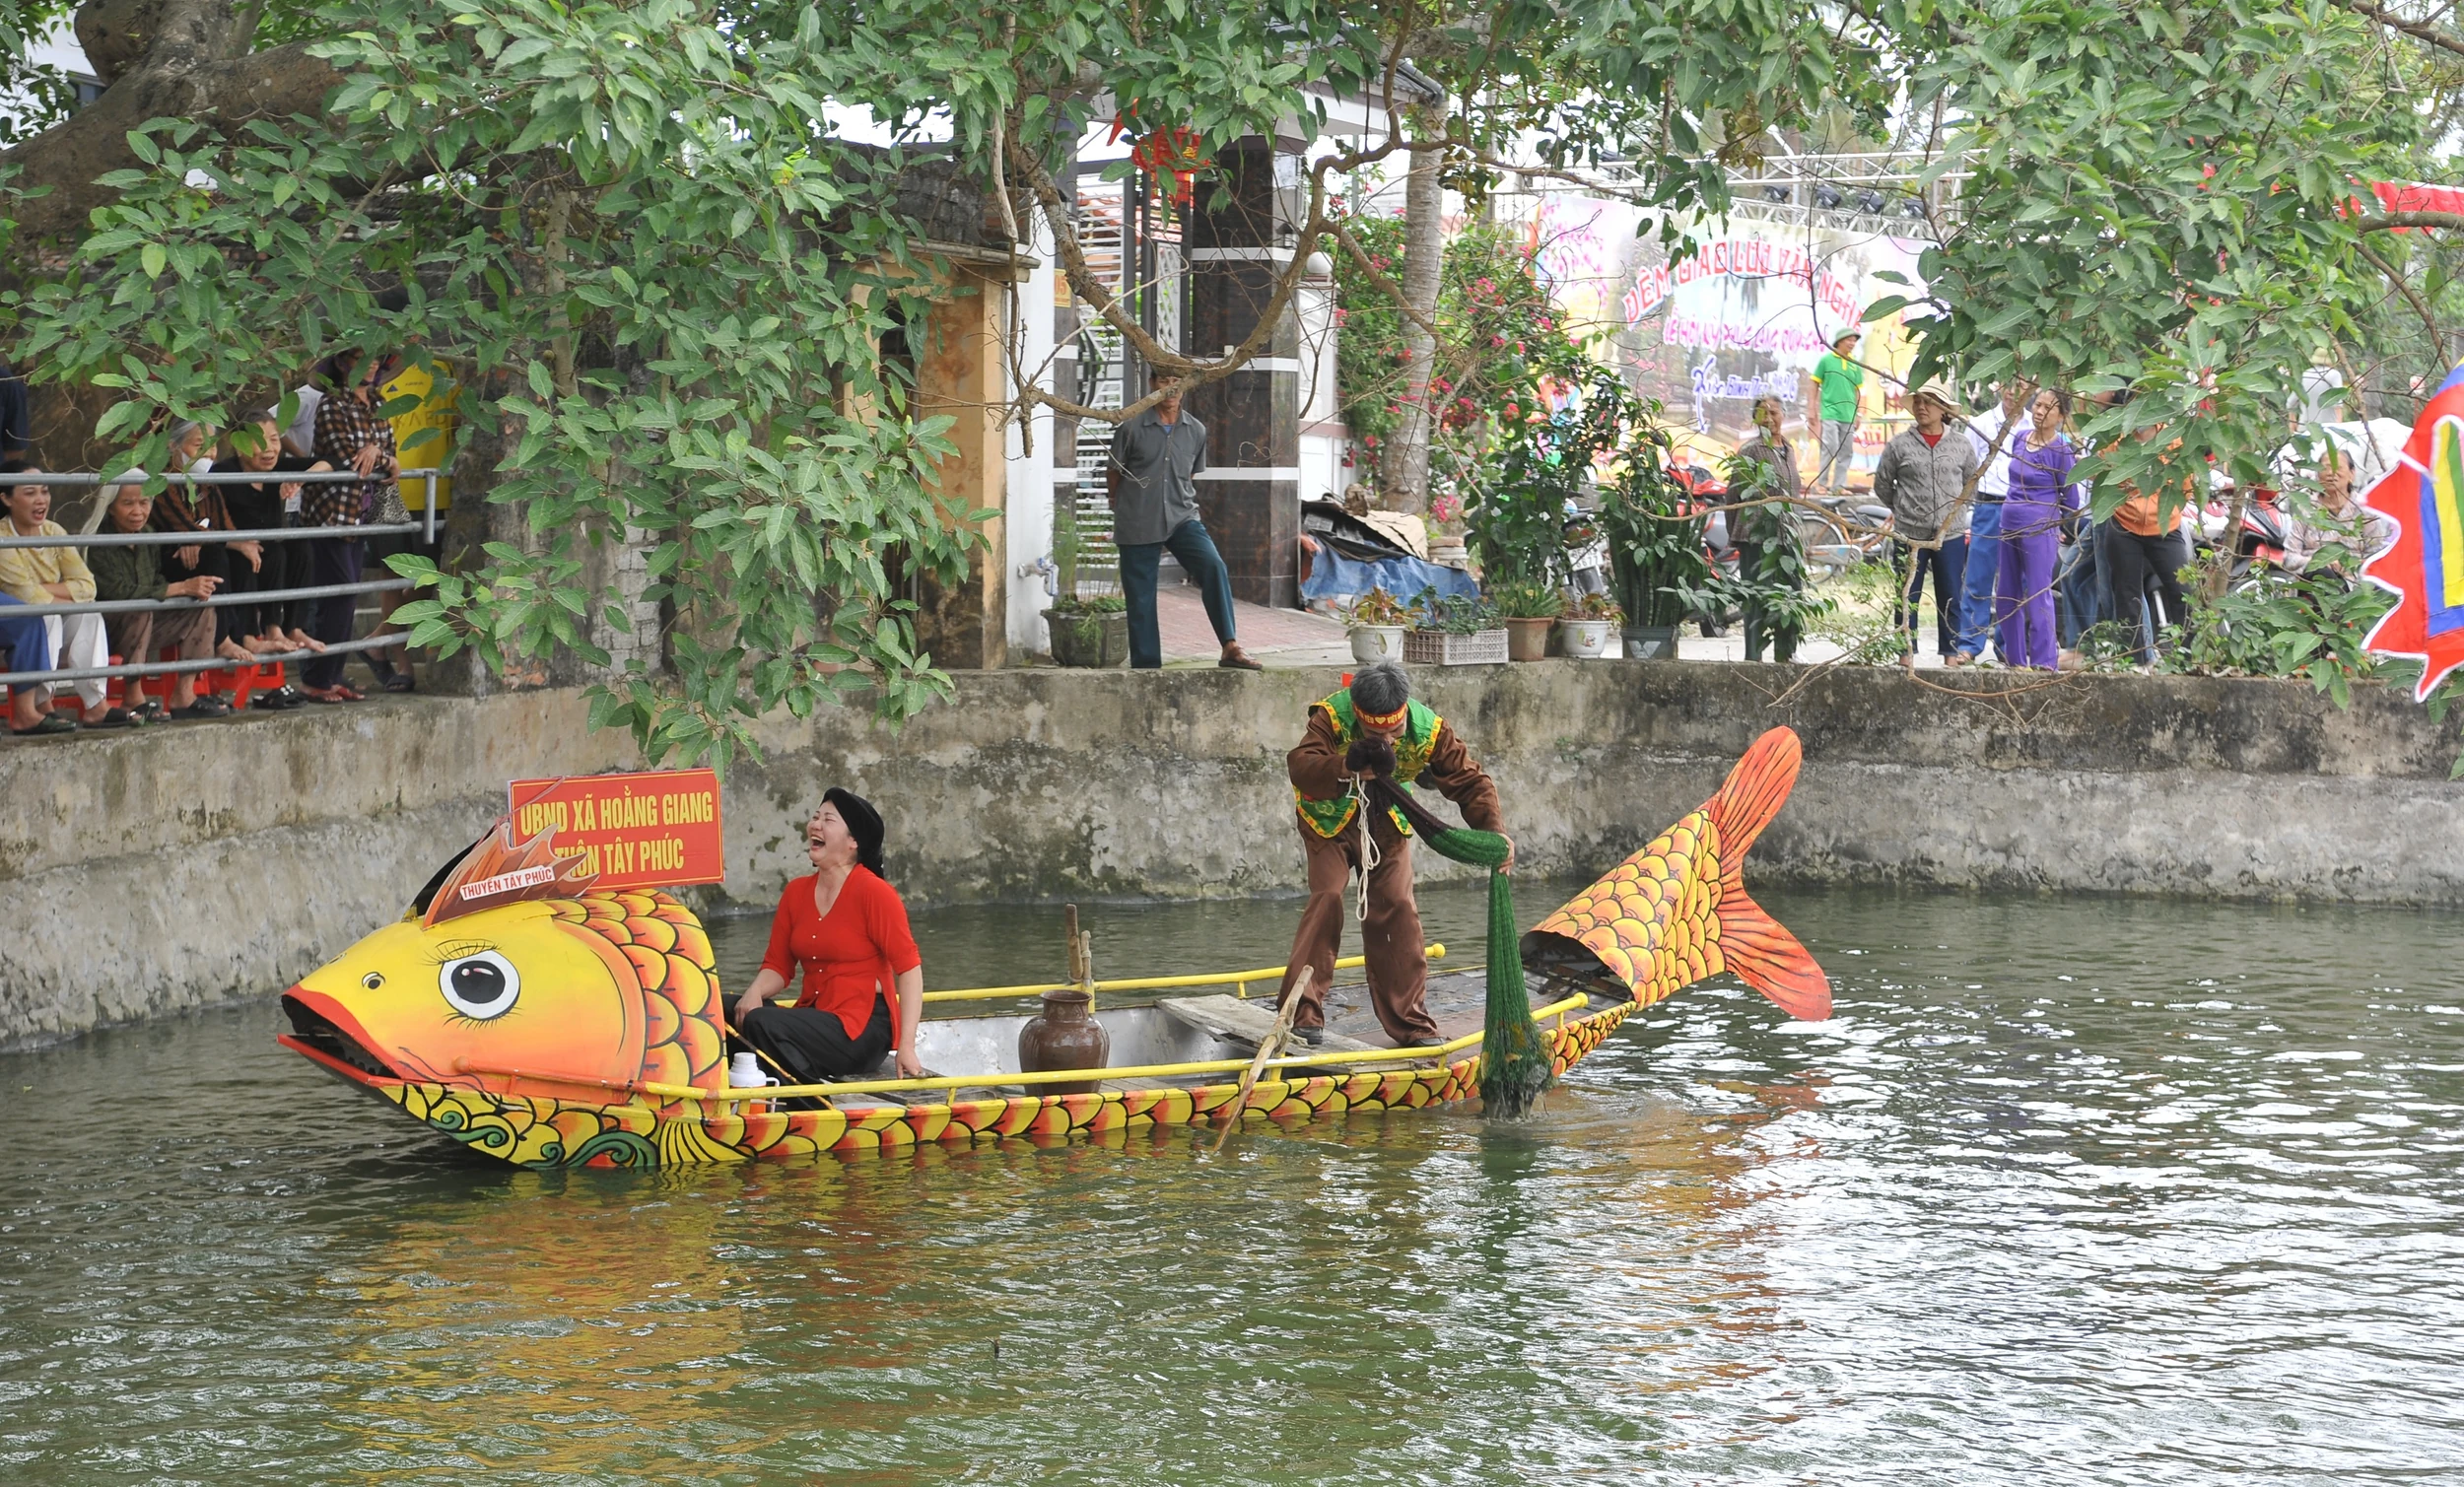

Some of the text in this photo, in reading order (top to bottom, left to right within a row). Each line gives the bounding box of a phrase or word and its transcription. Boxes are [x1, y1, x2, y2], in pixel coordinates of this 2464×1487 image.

[519, 784, 714, 836] UBND XÃ HOẰNG GIANG
[603, 837, 635, 875] TÂY
[639, 833, 685, 872] PHÚC
[503, 873, 522, 890] TÂY
[524, 867, 553, 885] PHÚC
